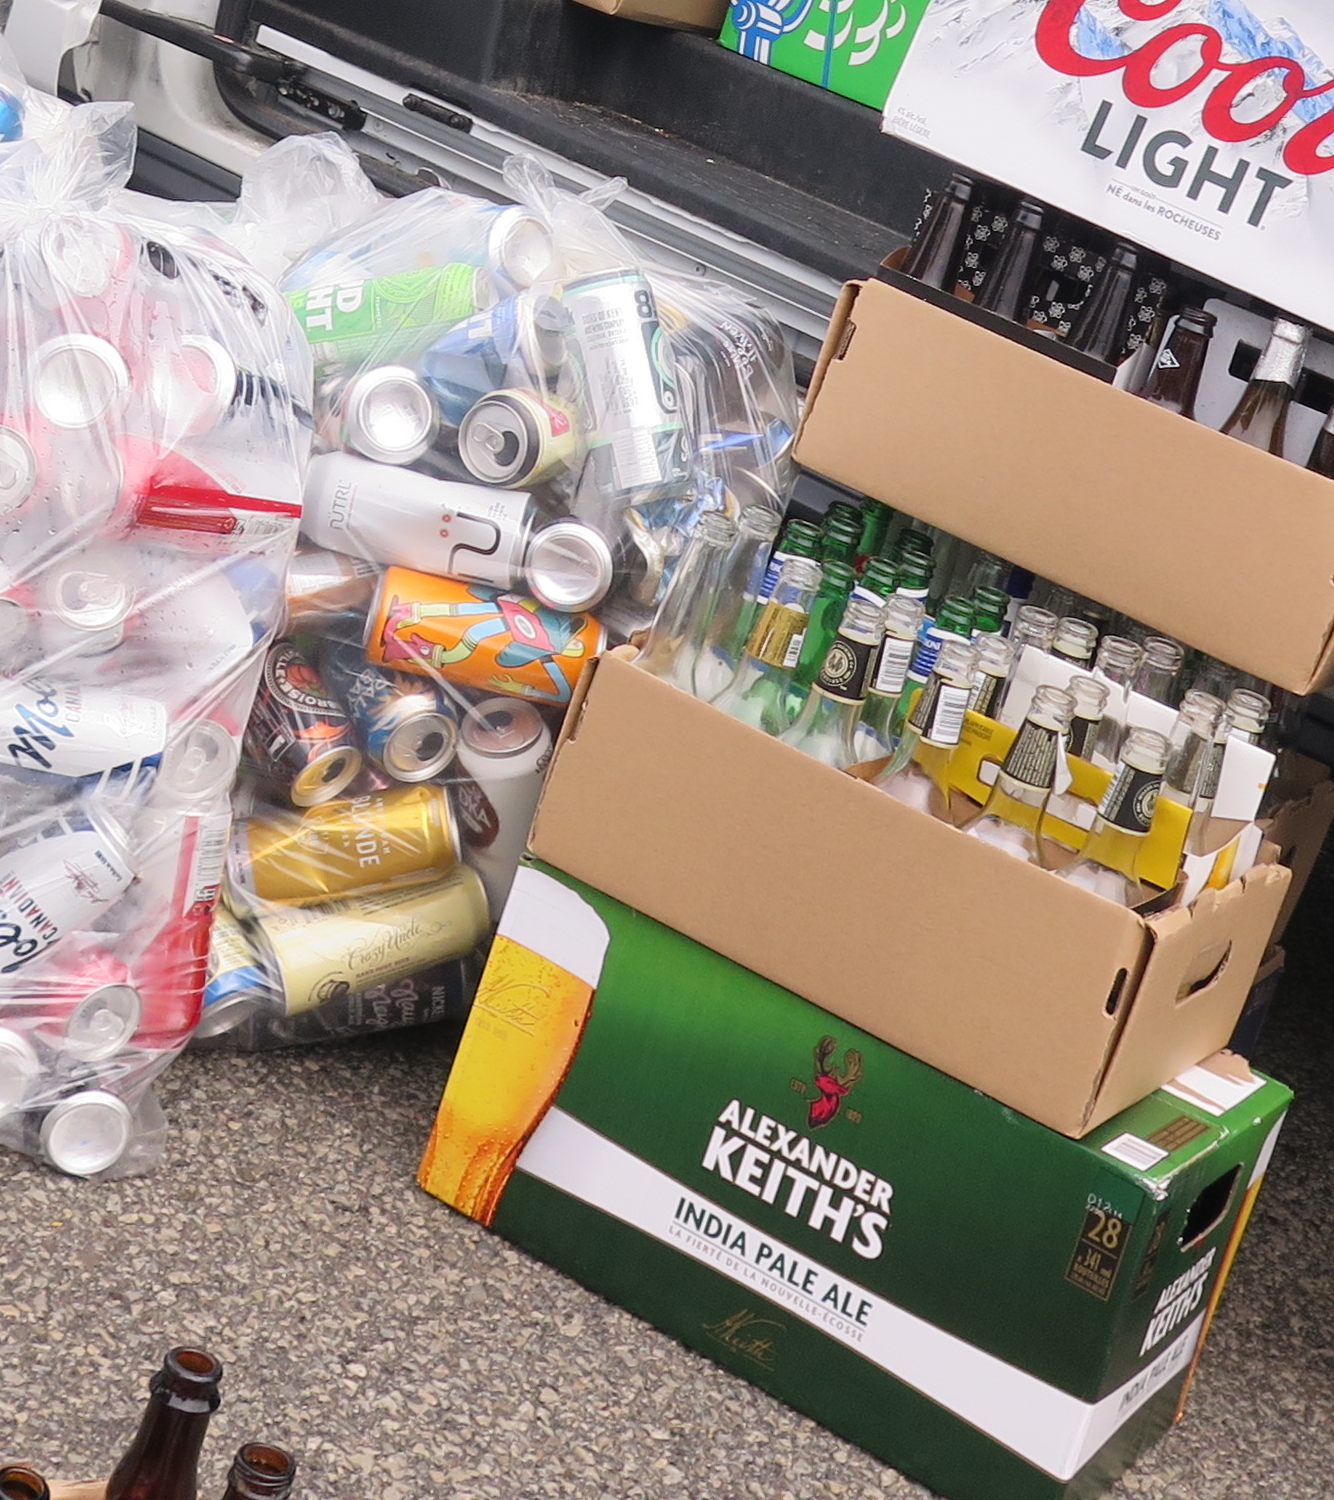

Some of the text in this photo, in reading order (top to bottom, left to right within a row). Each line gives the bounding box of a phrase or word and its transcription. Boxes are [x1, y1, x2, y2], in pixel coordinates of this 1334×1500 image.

[1079, 100, 1294, 232] LIGHT
[1123, 192, 1144, 208] dans
[1143, 199, 1156, 214] les
[1156, 205, 1223, 241] ROCHEUSES
[386, 917, 422, 951] Uncle
[701, 1125, 891, 1260] KEITH'S
[718, 1098, 895, 1215] ALEXANDER
[668, 1226, 865, 1343] LA FIERTÉ DE LA NOUVELLE-ÉCOSSE
[674, 1196, 873, 1327] INDIA PALE ALE
[1087, 1211, 1122, 1250] 28
